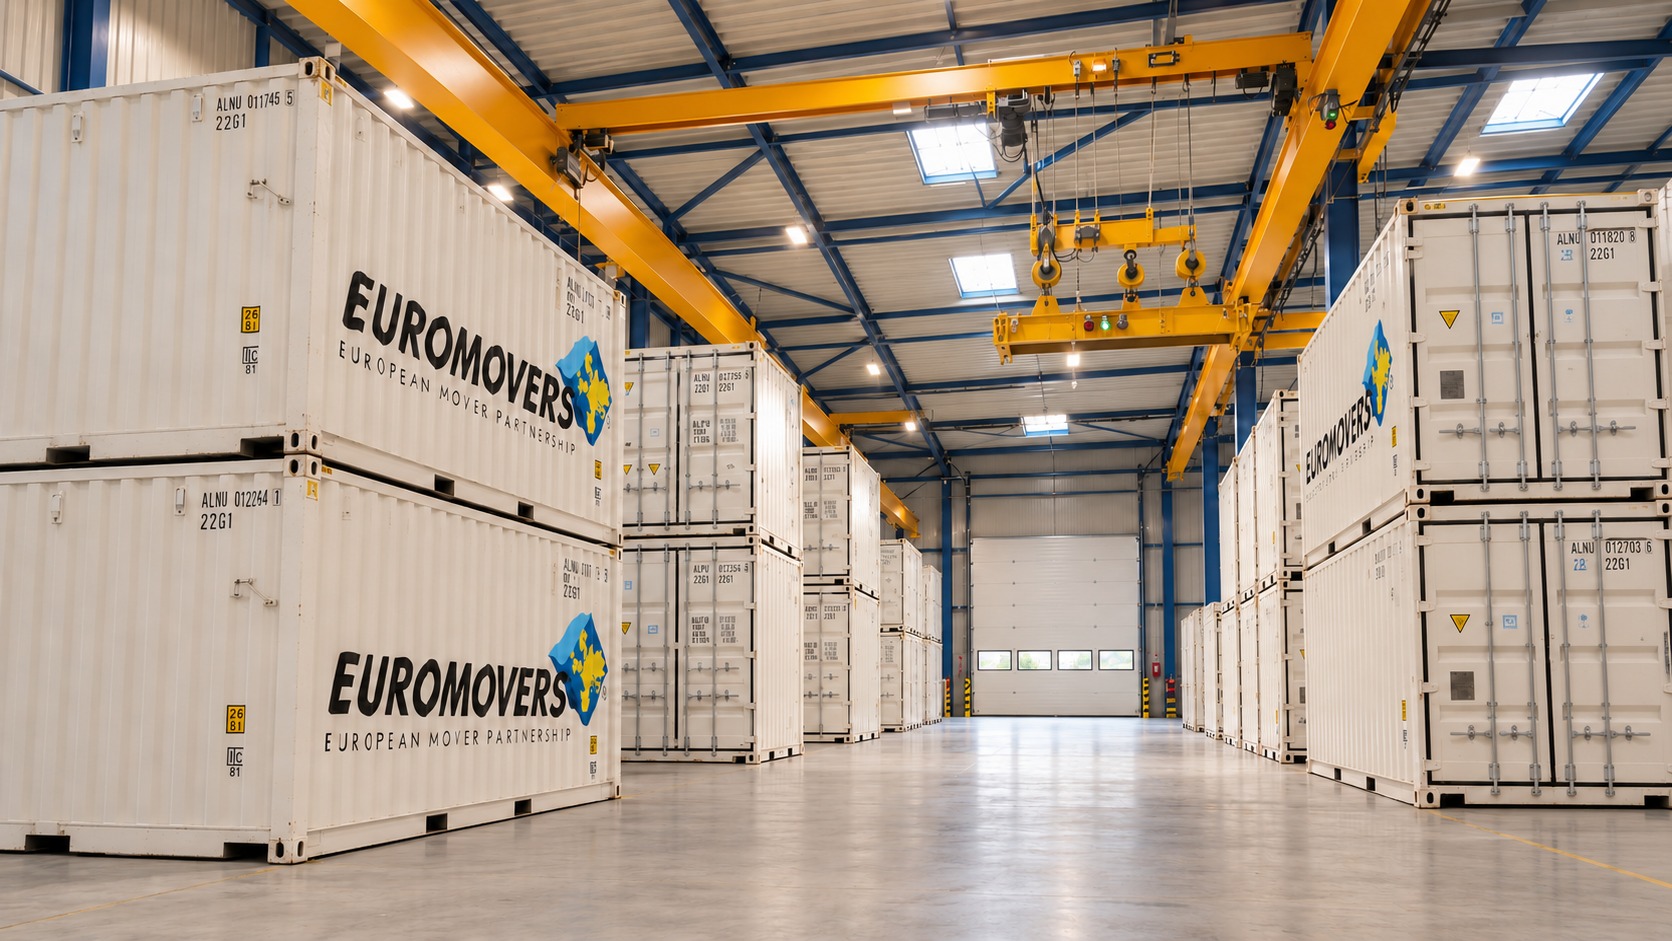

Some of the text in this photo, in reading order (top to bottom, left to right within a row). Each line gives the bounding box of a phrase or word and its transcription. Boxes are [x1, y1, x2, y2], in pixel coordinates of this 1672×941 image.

[216, 91, 293, 112] ALNU 011745 5
[216, 113, 246, 131] 22G1
[1557, 231, 1636, 245] ALNU 011820 8
[1590, 247, 1615, 260] 22G1
[245, 309, 258, 320] 26
[245, 320, 256, 331] 81
[342, 271, 575, 429] EUROMOVERS
[245, 364, 256, 375] 81
[339, 340, 576, 455] EUROPEAN MOVER PARTNERSHIP
[1306, 389, 1373, 485] EUROMOVERS
[202, 490, 228, 508] ALNU
[234, 489, 268, 507] 012264
[200, 512, 232, 530] 22G1
[1571, 541, 1652, 554] ALNU 012703 6
[1605, 558, 1630, 570] 22G1
[328, 651, 571, 718] EUROMOVERS
[229, 708, 243, 719] 26
[230, 720, 241, 731] 81
[325, 731, 420, 752] EUROPEAN
[428, 729, 479, 747] MOVER
[487, 728, 571, 745] PARTNERSHIP
[229, 767, 240, 777] 81
